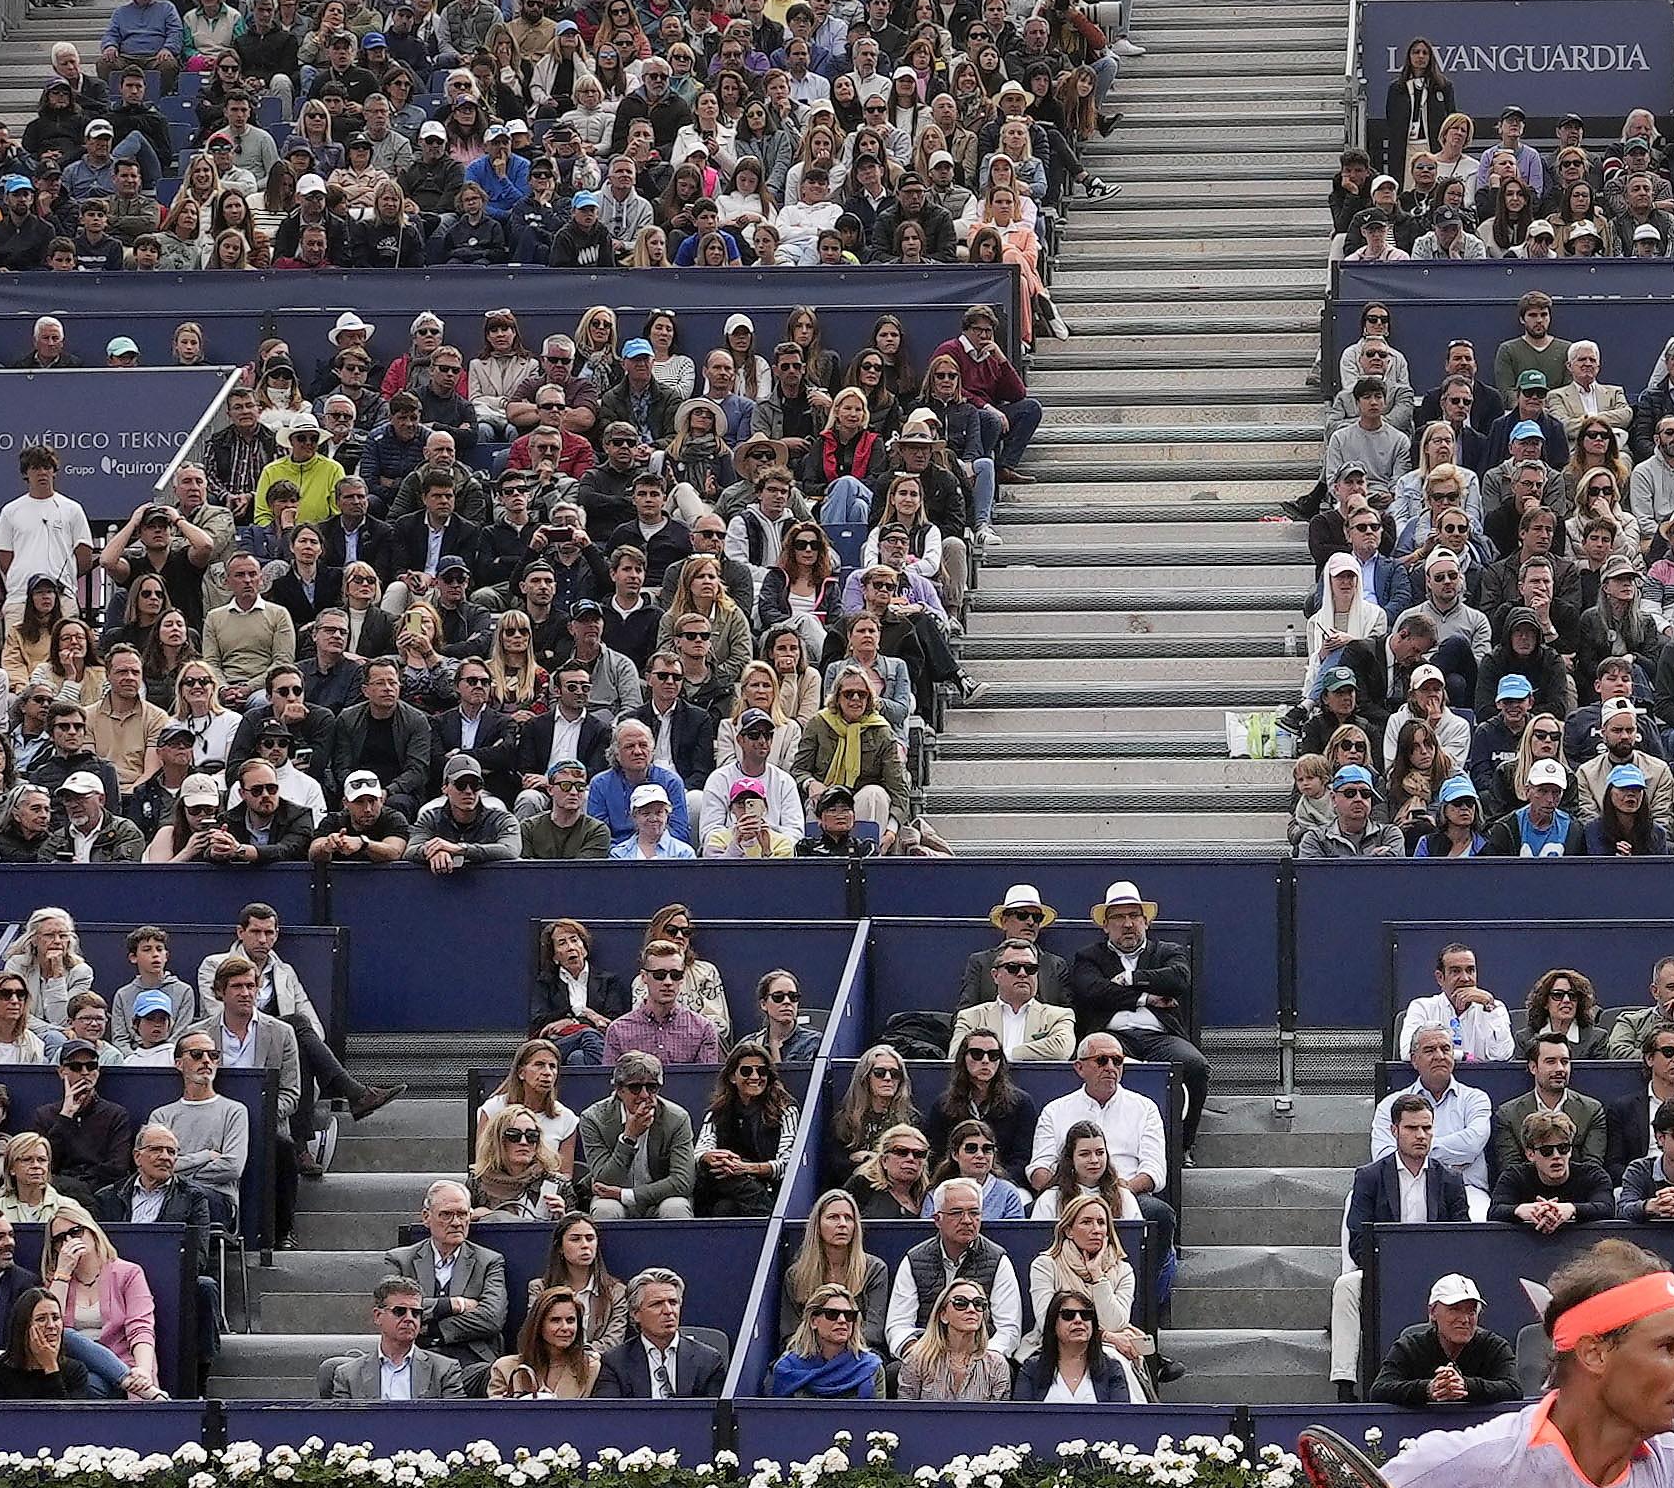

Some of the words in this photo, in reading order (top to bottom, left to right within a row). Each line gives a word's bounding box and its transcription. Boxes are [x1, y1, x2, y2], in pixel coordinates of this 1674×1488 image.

[1434, 43, 1650, 72] VANGUARDIA
[21, 428, 109, 450] MÉDICO
[118, 432, 189, 449] TEKNO
[65, 465, 95, 476] Grupo
